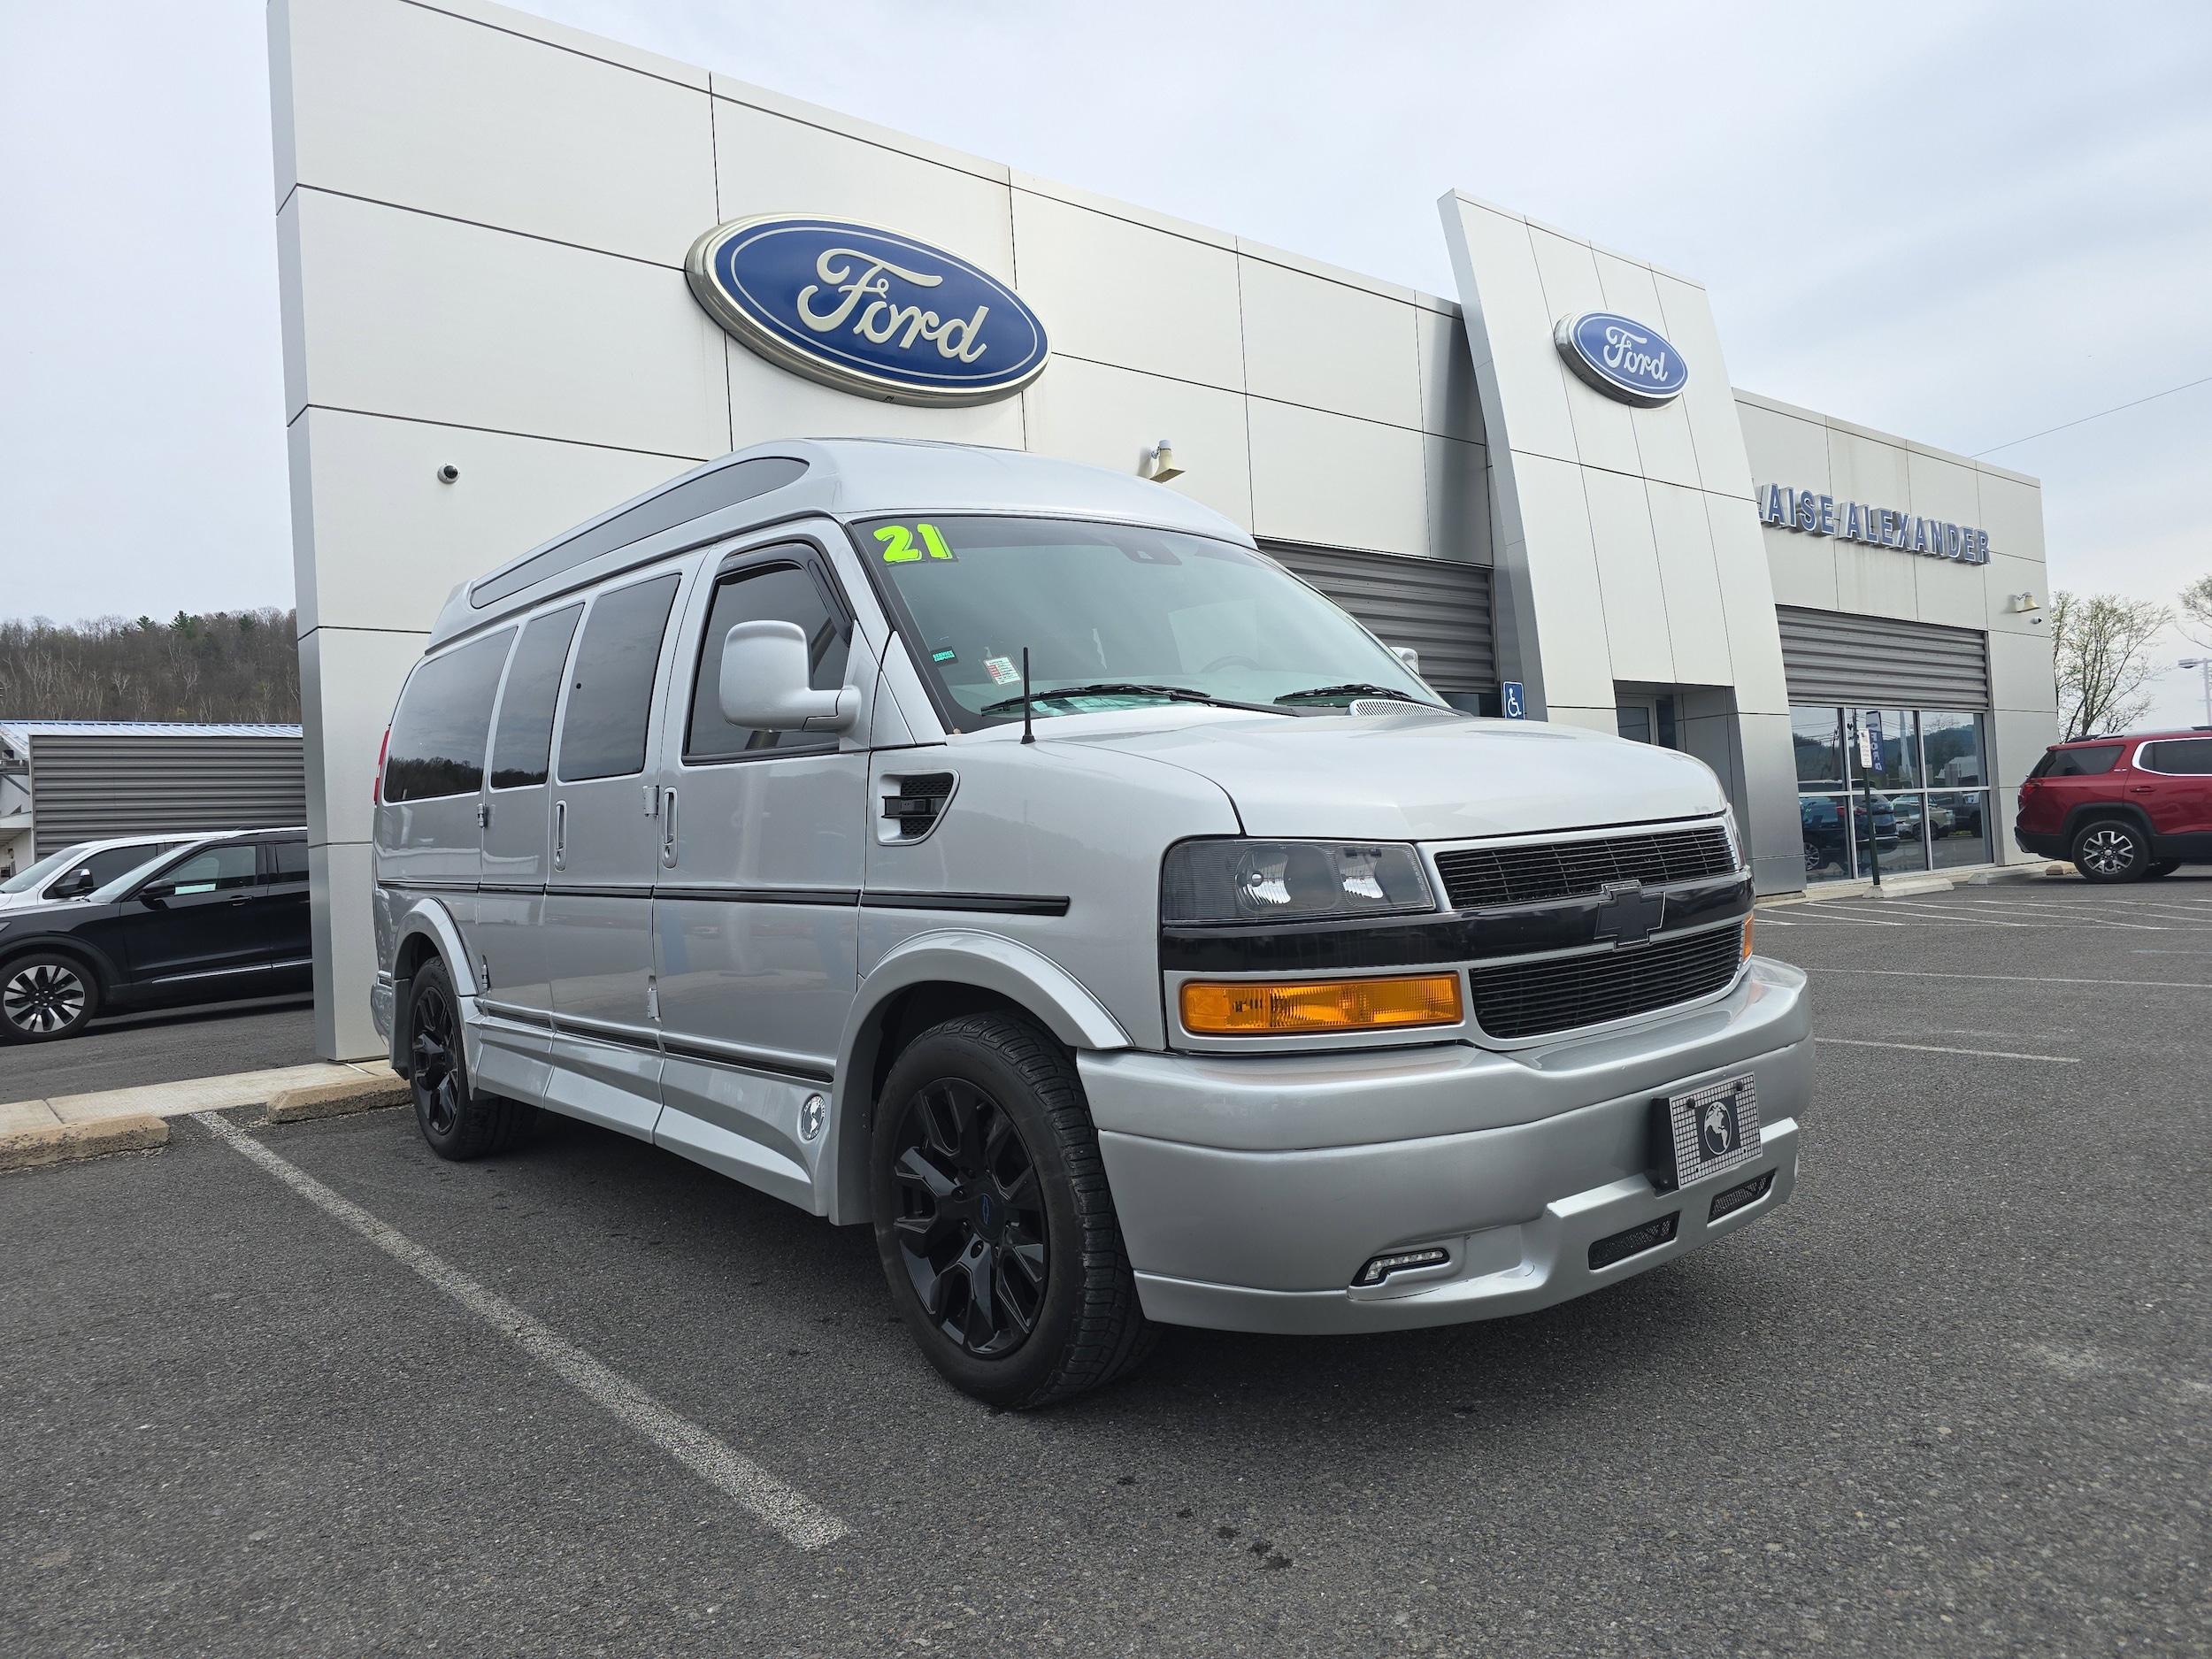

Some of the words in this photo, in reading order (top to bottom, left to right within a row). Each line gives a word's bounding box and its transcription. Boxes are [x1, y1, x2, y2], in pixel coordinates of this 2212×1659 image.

[797, 248, 990, 363] Ford
[1603, 326, 1668, 381] Ford
[873, 524, 953, 562] 21
[1846, 501, 1991, 565] ALEXANDER
